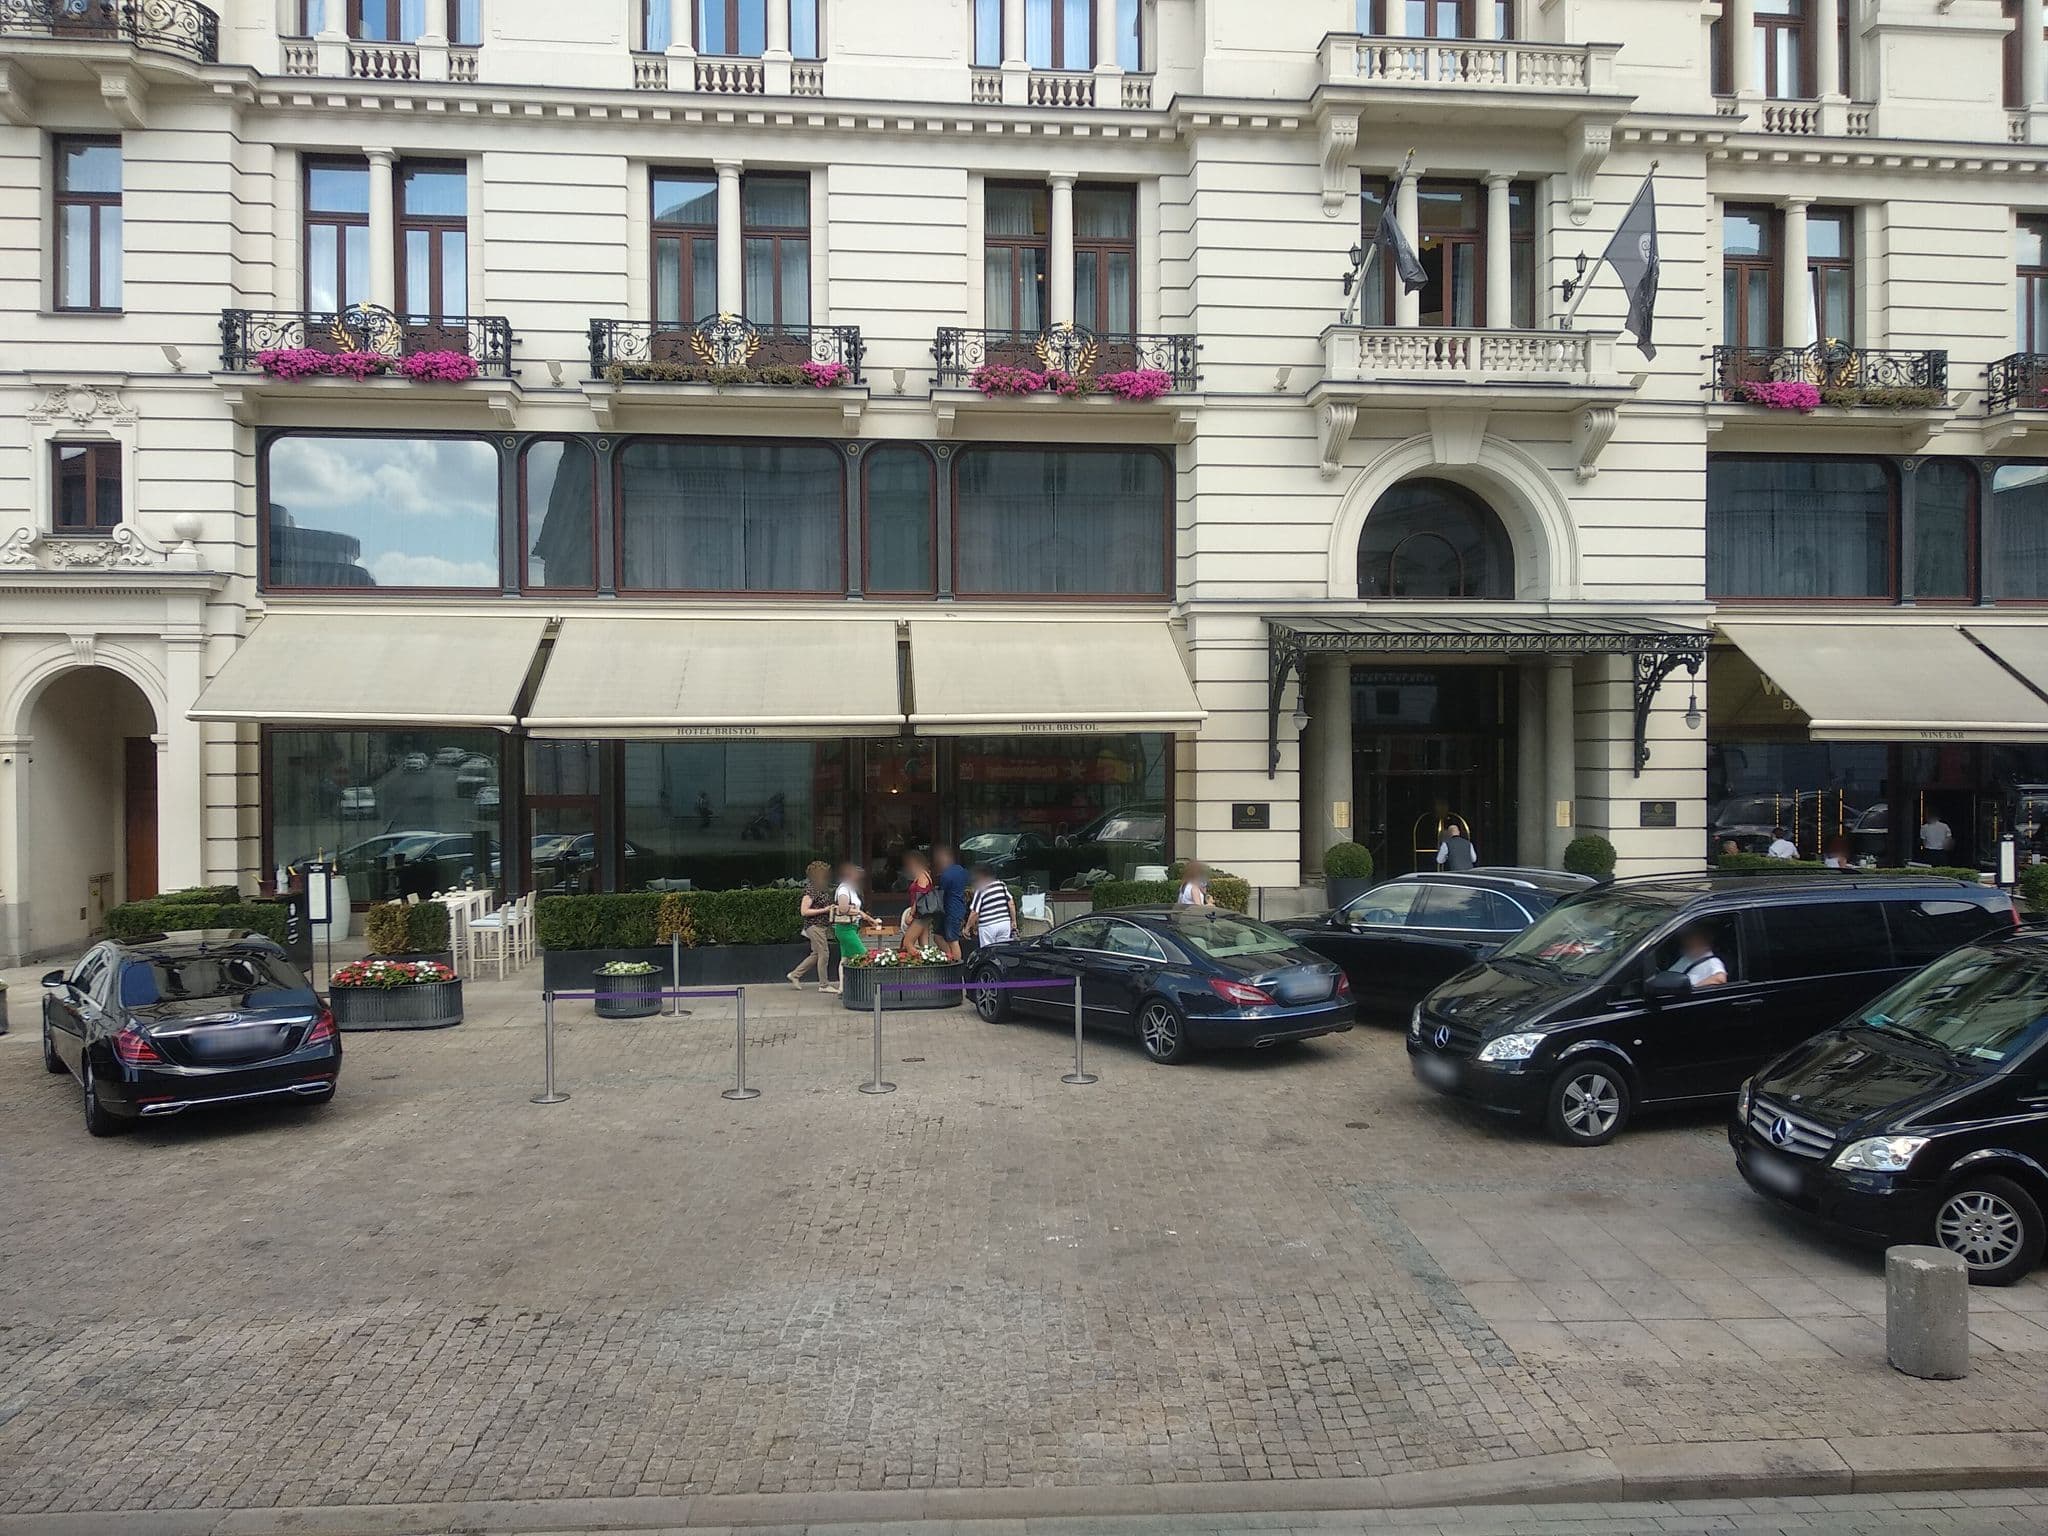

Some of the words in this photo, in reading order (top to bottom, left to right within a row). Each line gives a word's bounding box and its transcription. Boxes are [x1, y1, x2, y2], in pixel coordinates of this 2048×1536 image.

[677, 727, 713, 736] HOTEL
[714, 727, 759, 736] BRISTOL
[1021, 723, 1055, 732] HOTEL
[1056, 723, 1099, 732] BRISTOL
[1920, 731, 1945, 739] WINE
[1946, 731, 1965, 739] BAR
